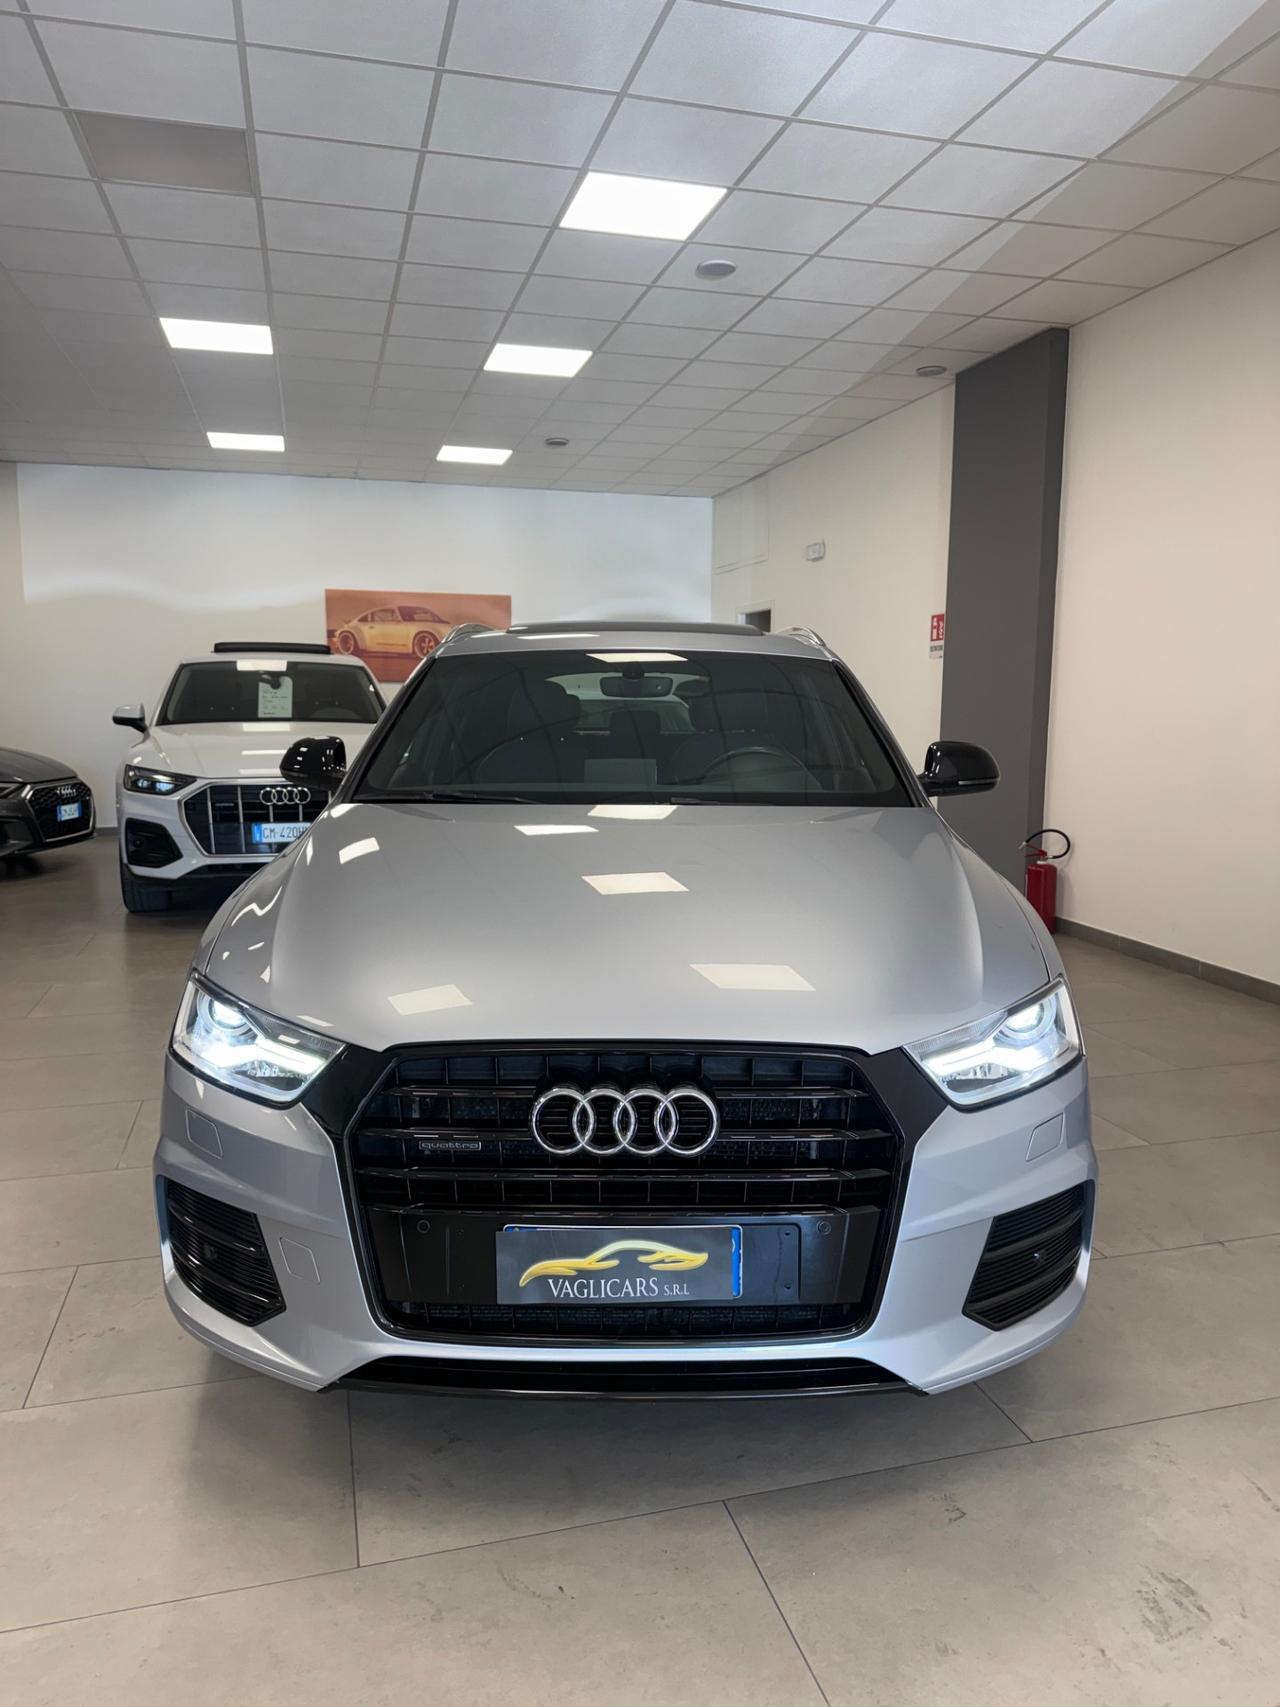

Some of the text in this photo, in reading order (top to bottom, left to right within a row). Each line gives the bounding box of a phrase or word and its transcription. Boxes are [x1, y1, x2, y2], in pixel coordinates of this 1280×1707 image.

[421, 1142, 479, 1150] quattro
[548, 1277, 690, 1298] VAGLICARS S.R.L
